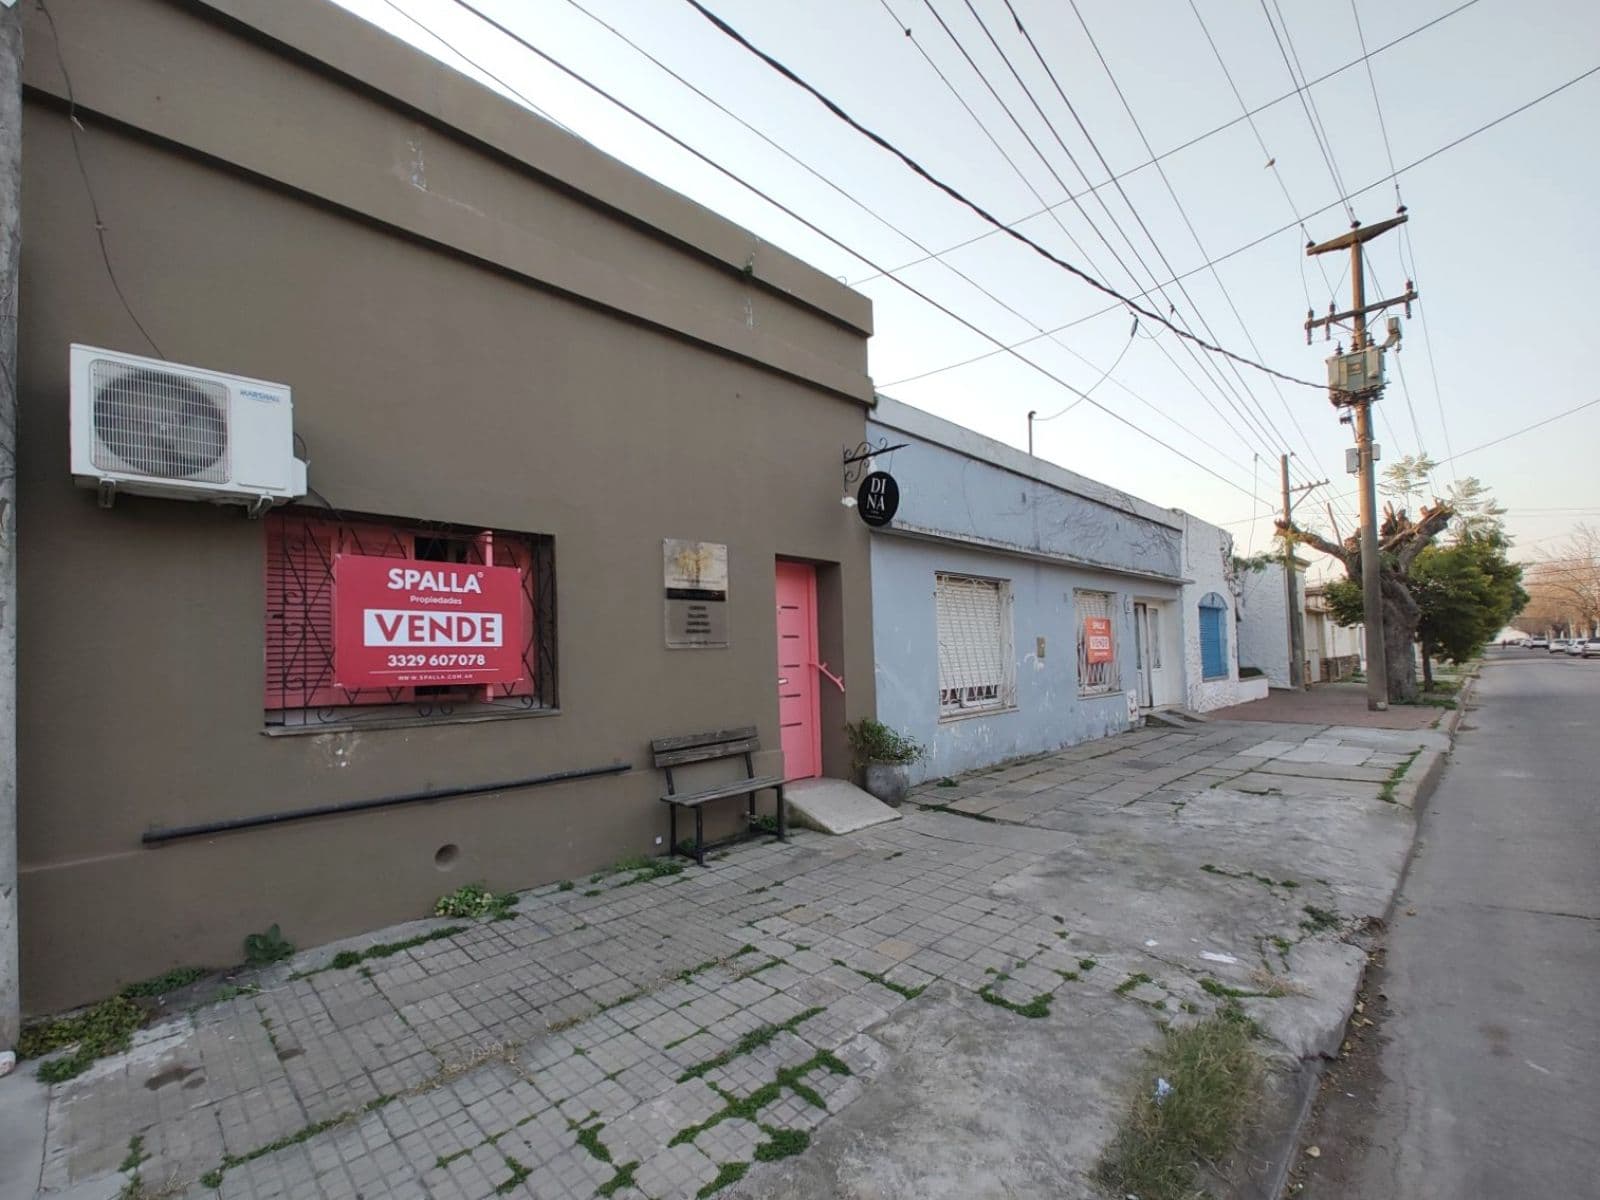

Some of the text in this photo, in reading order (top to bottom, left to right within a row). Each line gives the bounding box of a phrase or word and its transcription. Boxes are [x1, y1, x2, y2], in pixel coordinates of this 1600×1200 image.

[870, 477, 887, 494] DI
[866, 494, 885, 511] NA
[387, 568, 482, 594] SPALLA
[410, 595, 462, 605] Propiedades
[374, 613, 496, 643] VENDE
[387, 654, 486, 667] 3329 607078
